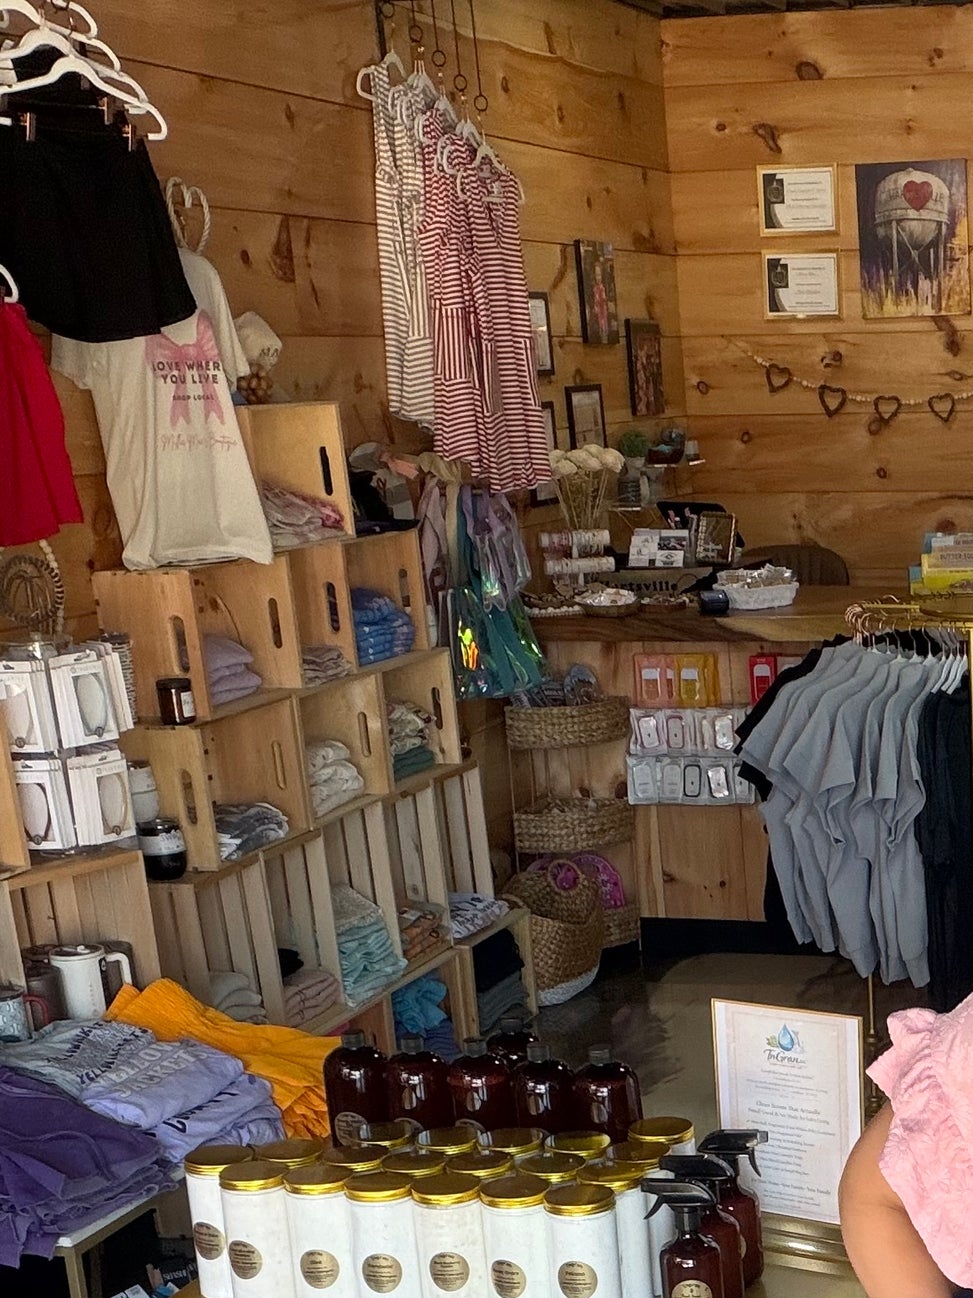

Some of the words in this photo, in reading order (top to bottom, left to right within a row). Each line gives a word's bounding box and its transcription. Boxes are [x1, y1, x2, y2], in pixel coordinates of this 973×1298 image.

[186, 360, 222, 372] WHER
[161, 373, 187, 385] YOU
[192, 373, 219, 385] LIVE
